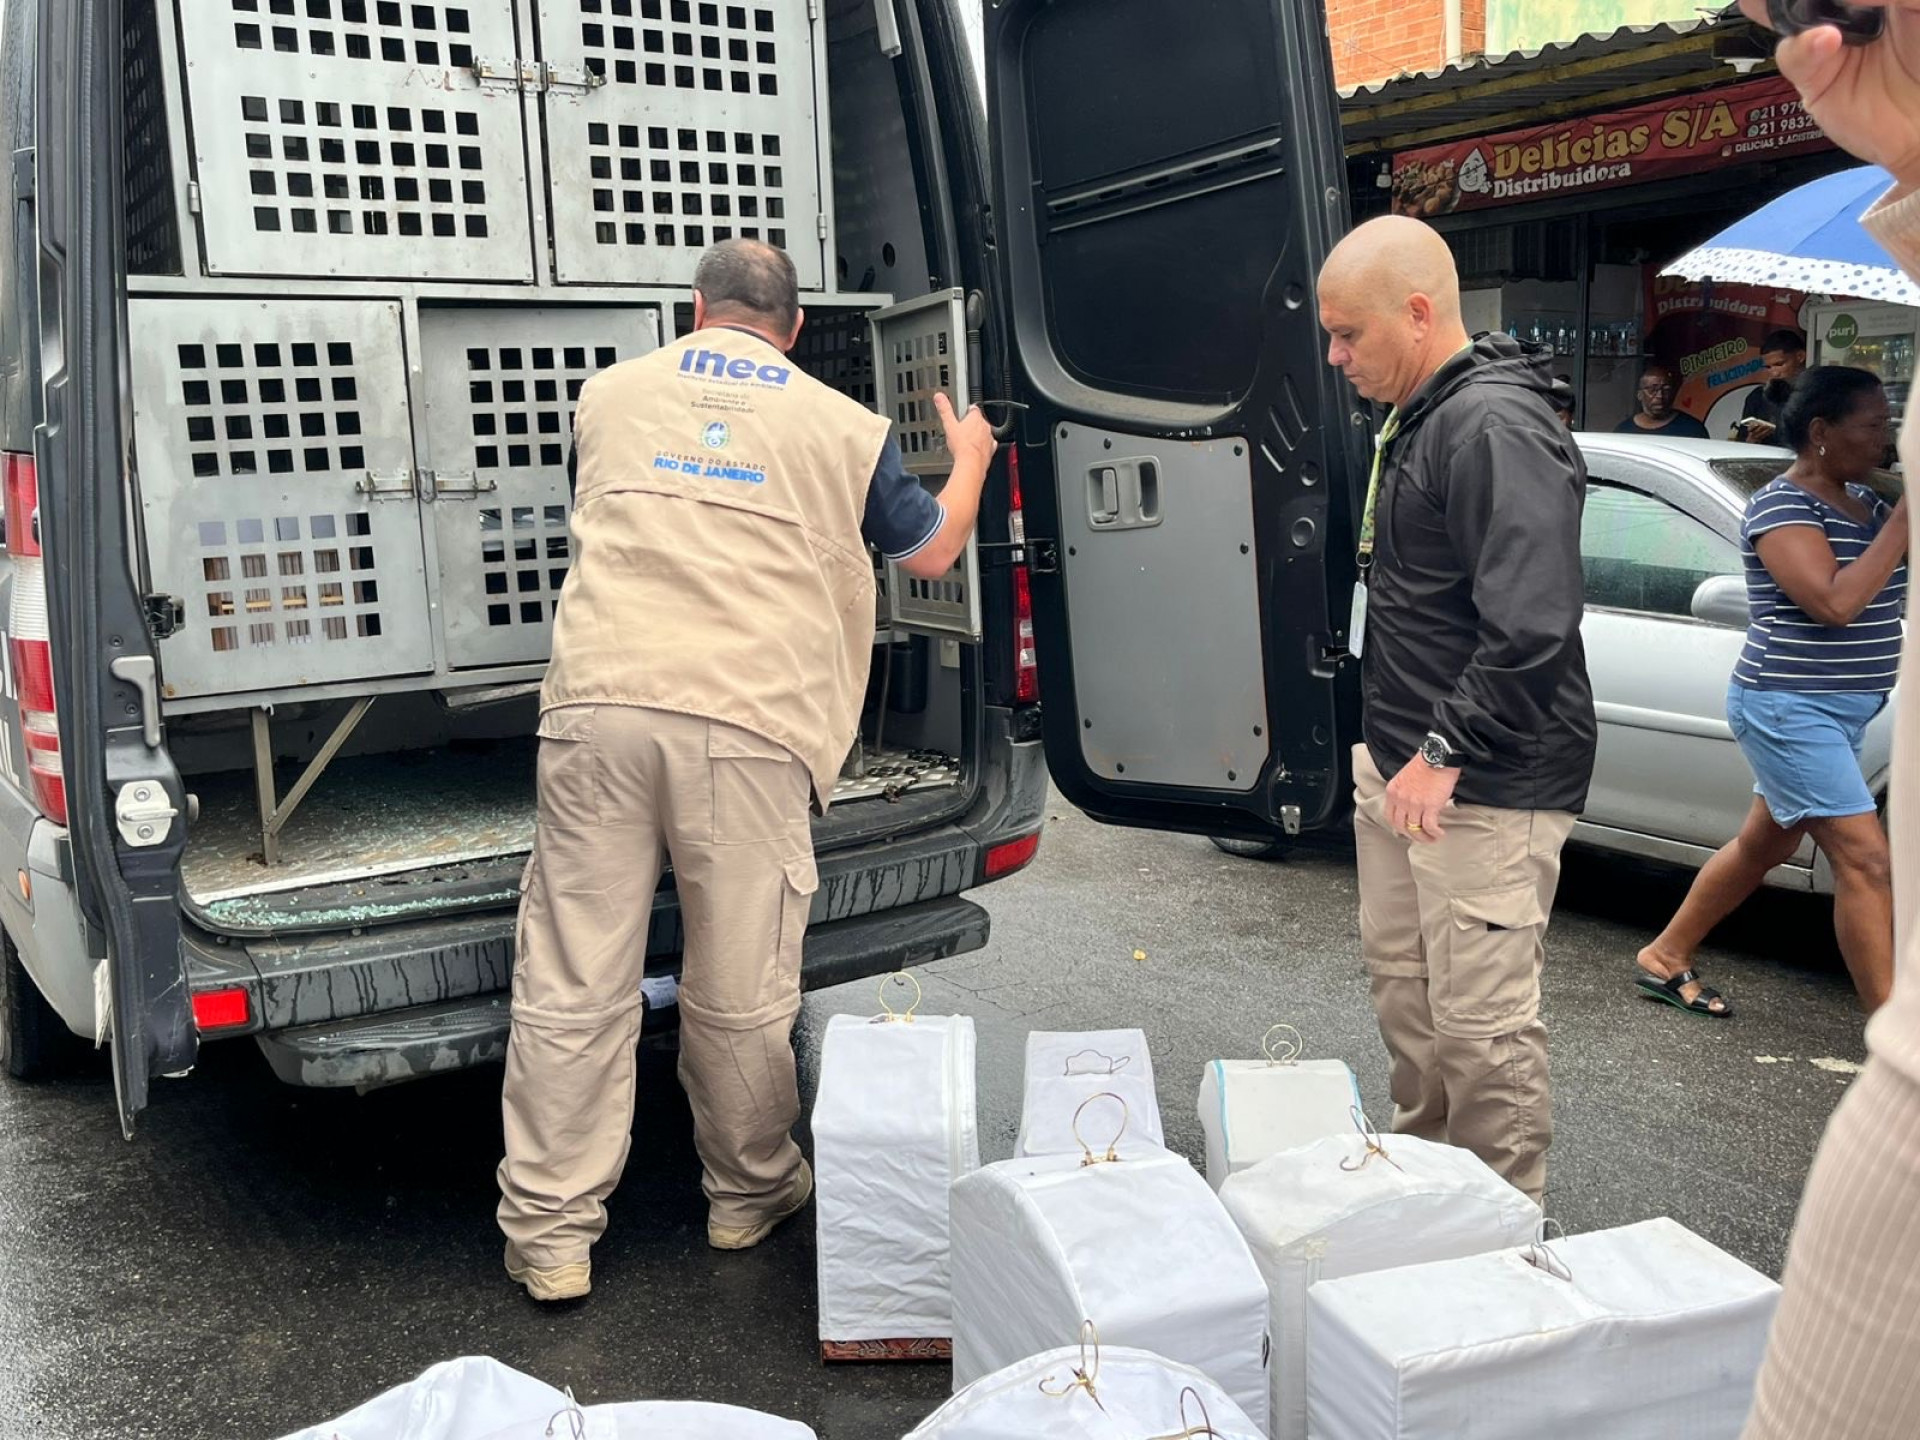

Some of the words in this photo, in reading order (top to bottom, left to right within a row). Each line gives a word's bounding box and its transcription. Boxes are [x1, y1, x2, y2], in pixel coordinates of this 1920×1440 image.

[1761, 105, 1776, 120] 21
[1493, 124, 1651, 179] Delícias
[1661, 100, 1739, 149] S/A
[1760, 121, 1775, 135] 21
[1492, 162, 1632, 198] Distribuidora
[1679, 337, 1748, 376] DINHEIRO
[653, 457, 679, 470] RIO
[682, 462, 701, 475] DE
[703, 465, 765, 483] JANEIRO
[656, 450, 704, 464] GOVERNO
[708, 458, 721, 466] DO
[726, 460, 766, 472] ESTADO
